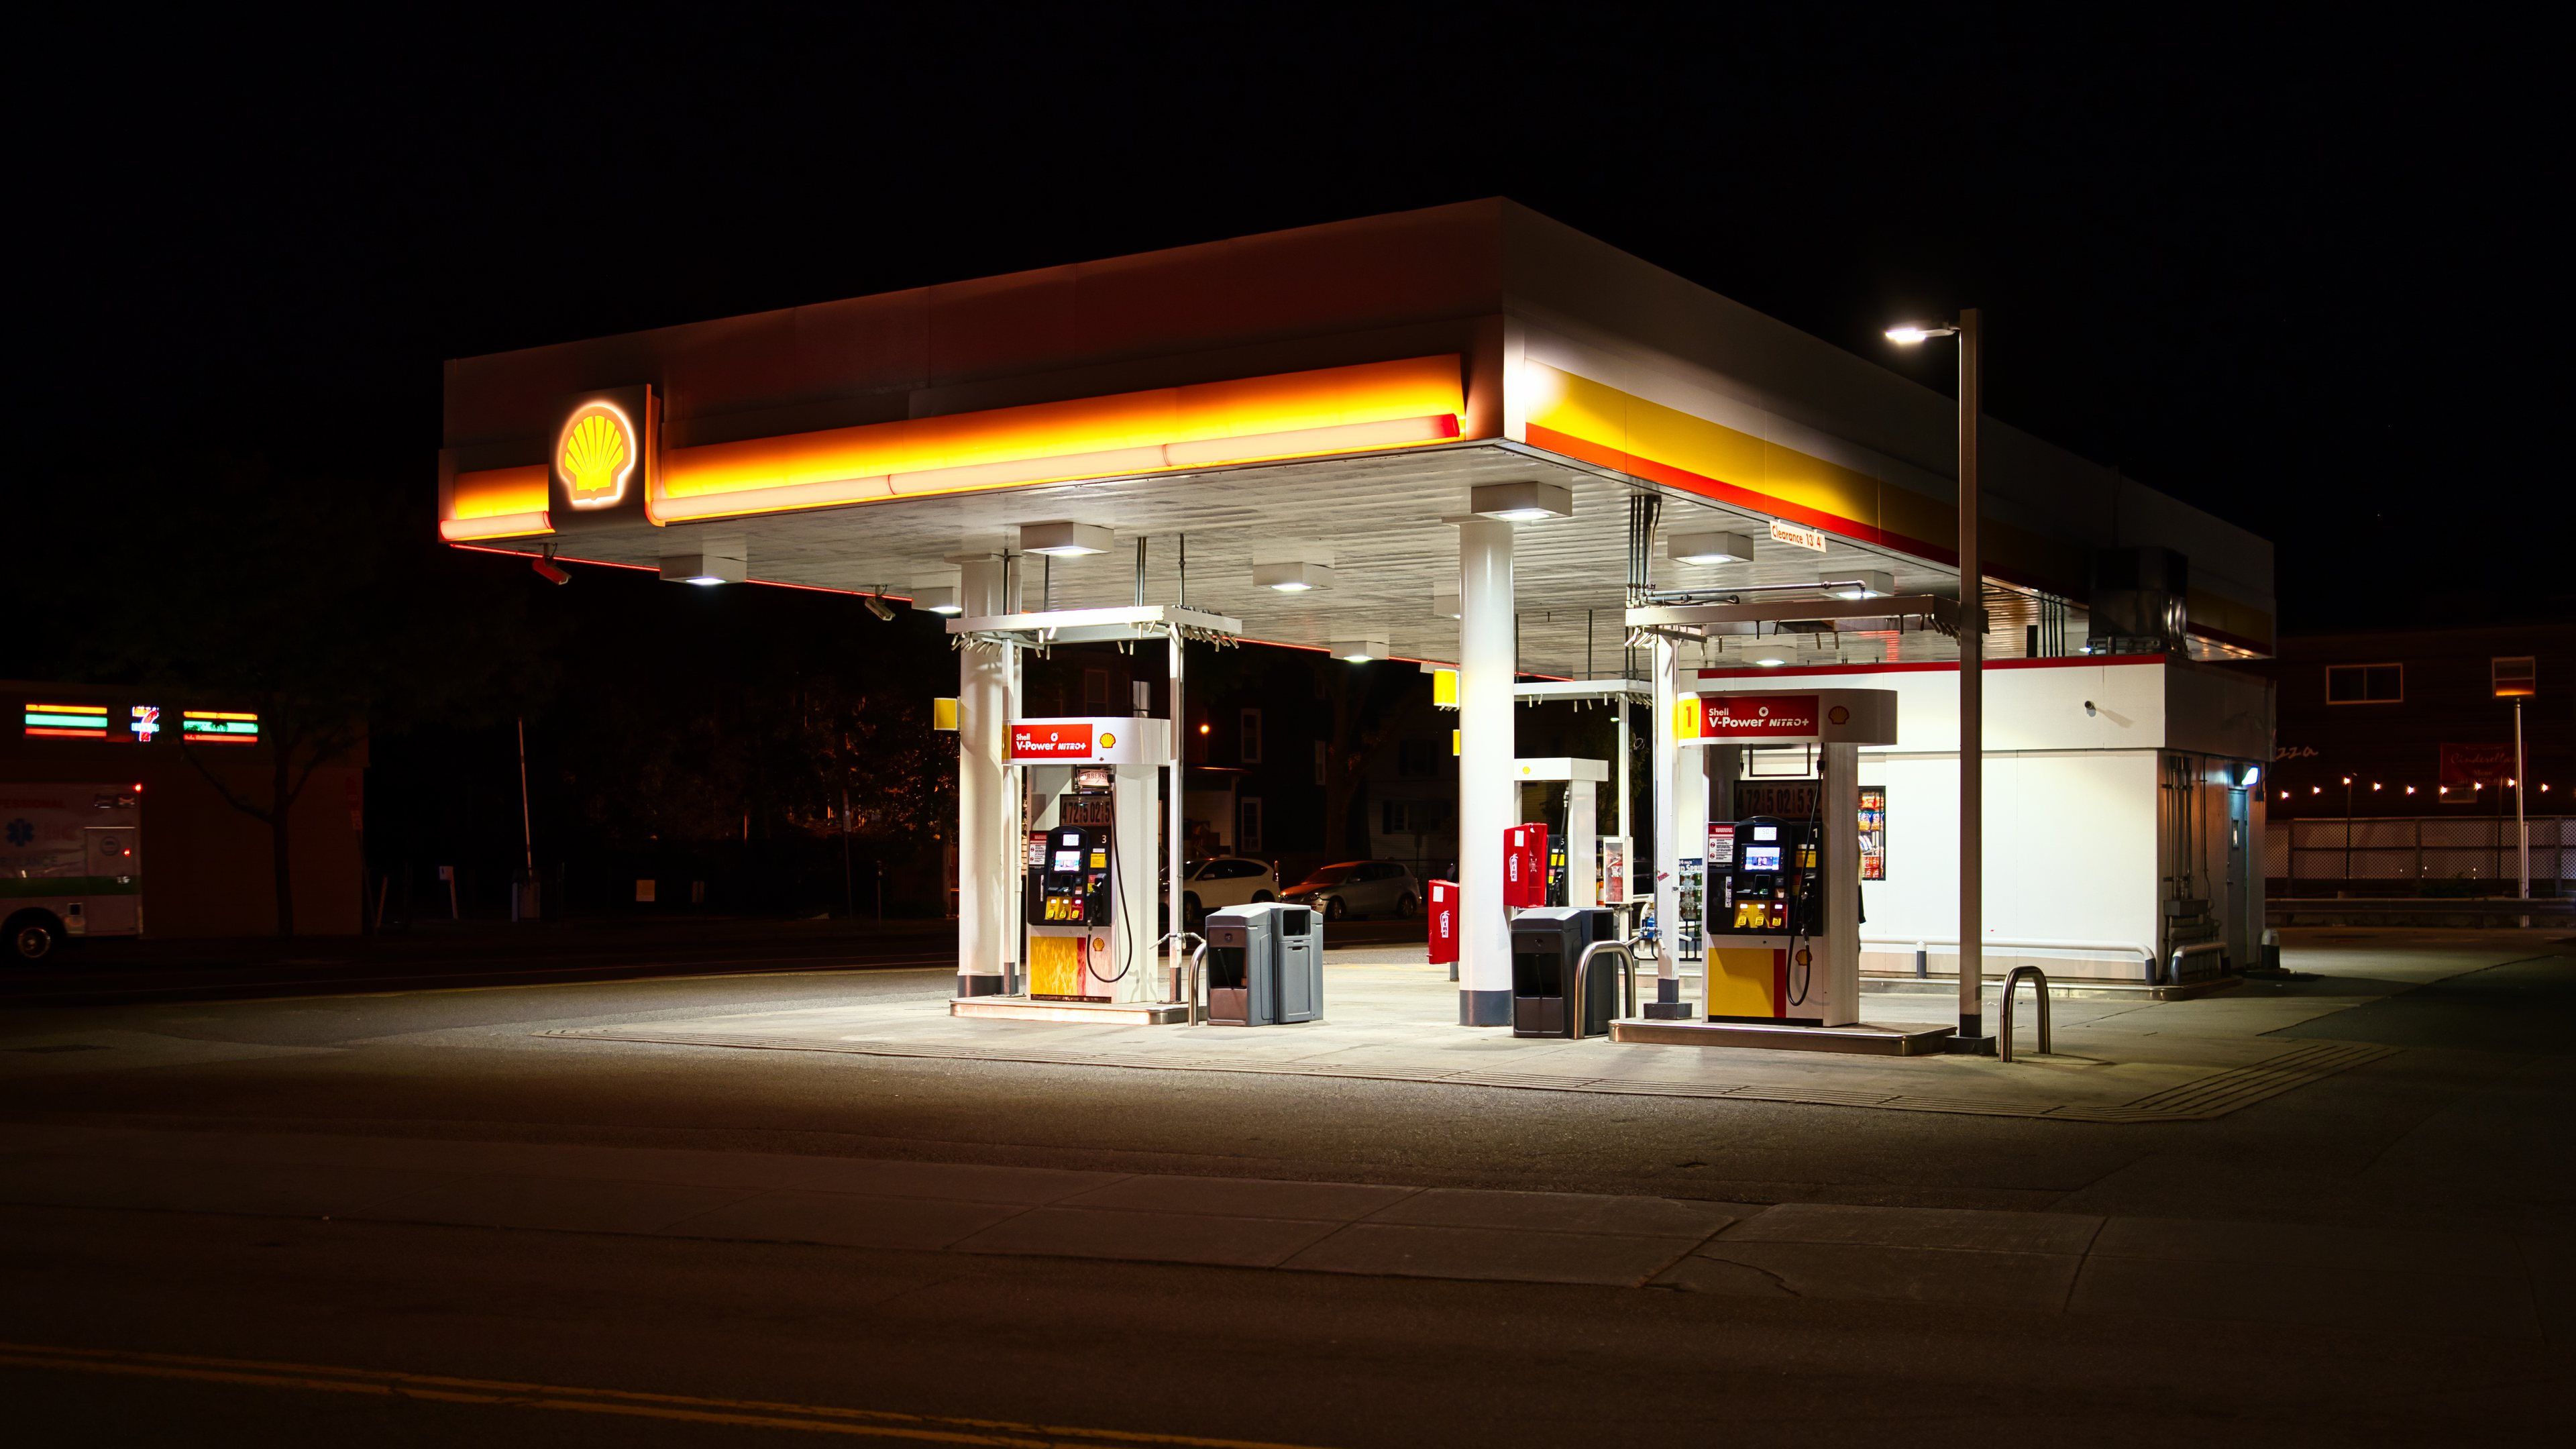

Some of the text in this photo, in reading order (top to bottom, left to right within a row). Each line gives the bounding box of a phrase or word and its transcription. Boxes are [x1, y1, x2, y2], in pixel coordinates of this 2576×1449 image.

[1772, 525, 1803, 545] Clearance
[1806, 533, 1815, 547] 13'
[1686, 706, 1692, 727] 1
[1709, 708, 1729, 716] Shell
[132, 706, 159, 742] 7
[1709, 717, 1764, 727] V-Power
[1016, 733, 1030, 741] Shell
[1016, 741, 1055, 751] V-Power
[2275, 746, 2319, 760] zza
[2450, 752, 2516, 764] Cinderella
[1813, 828, 1818, 839] 1
[1102, 835, 1107, 844] 3
